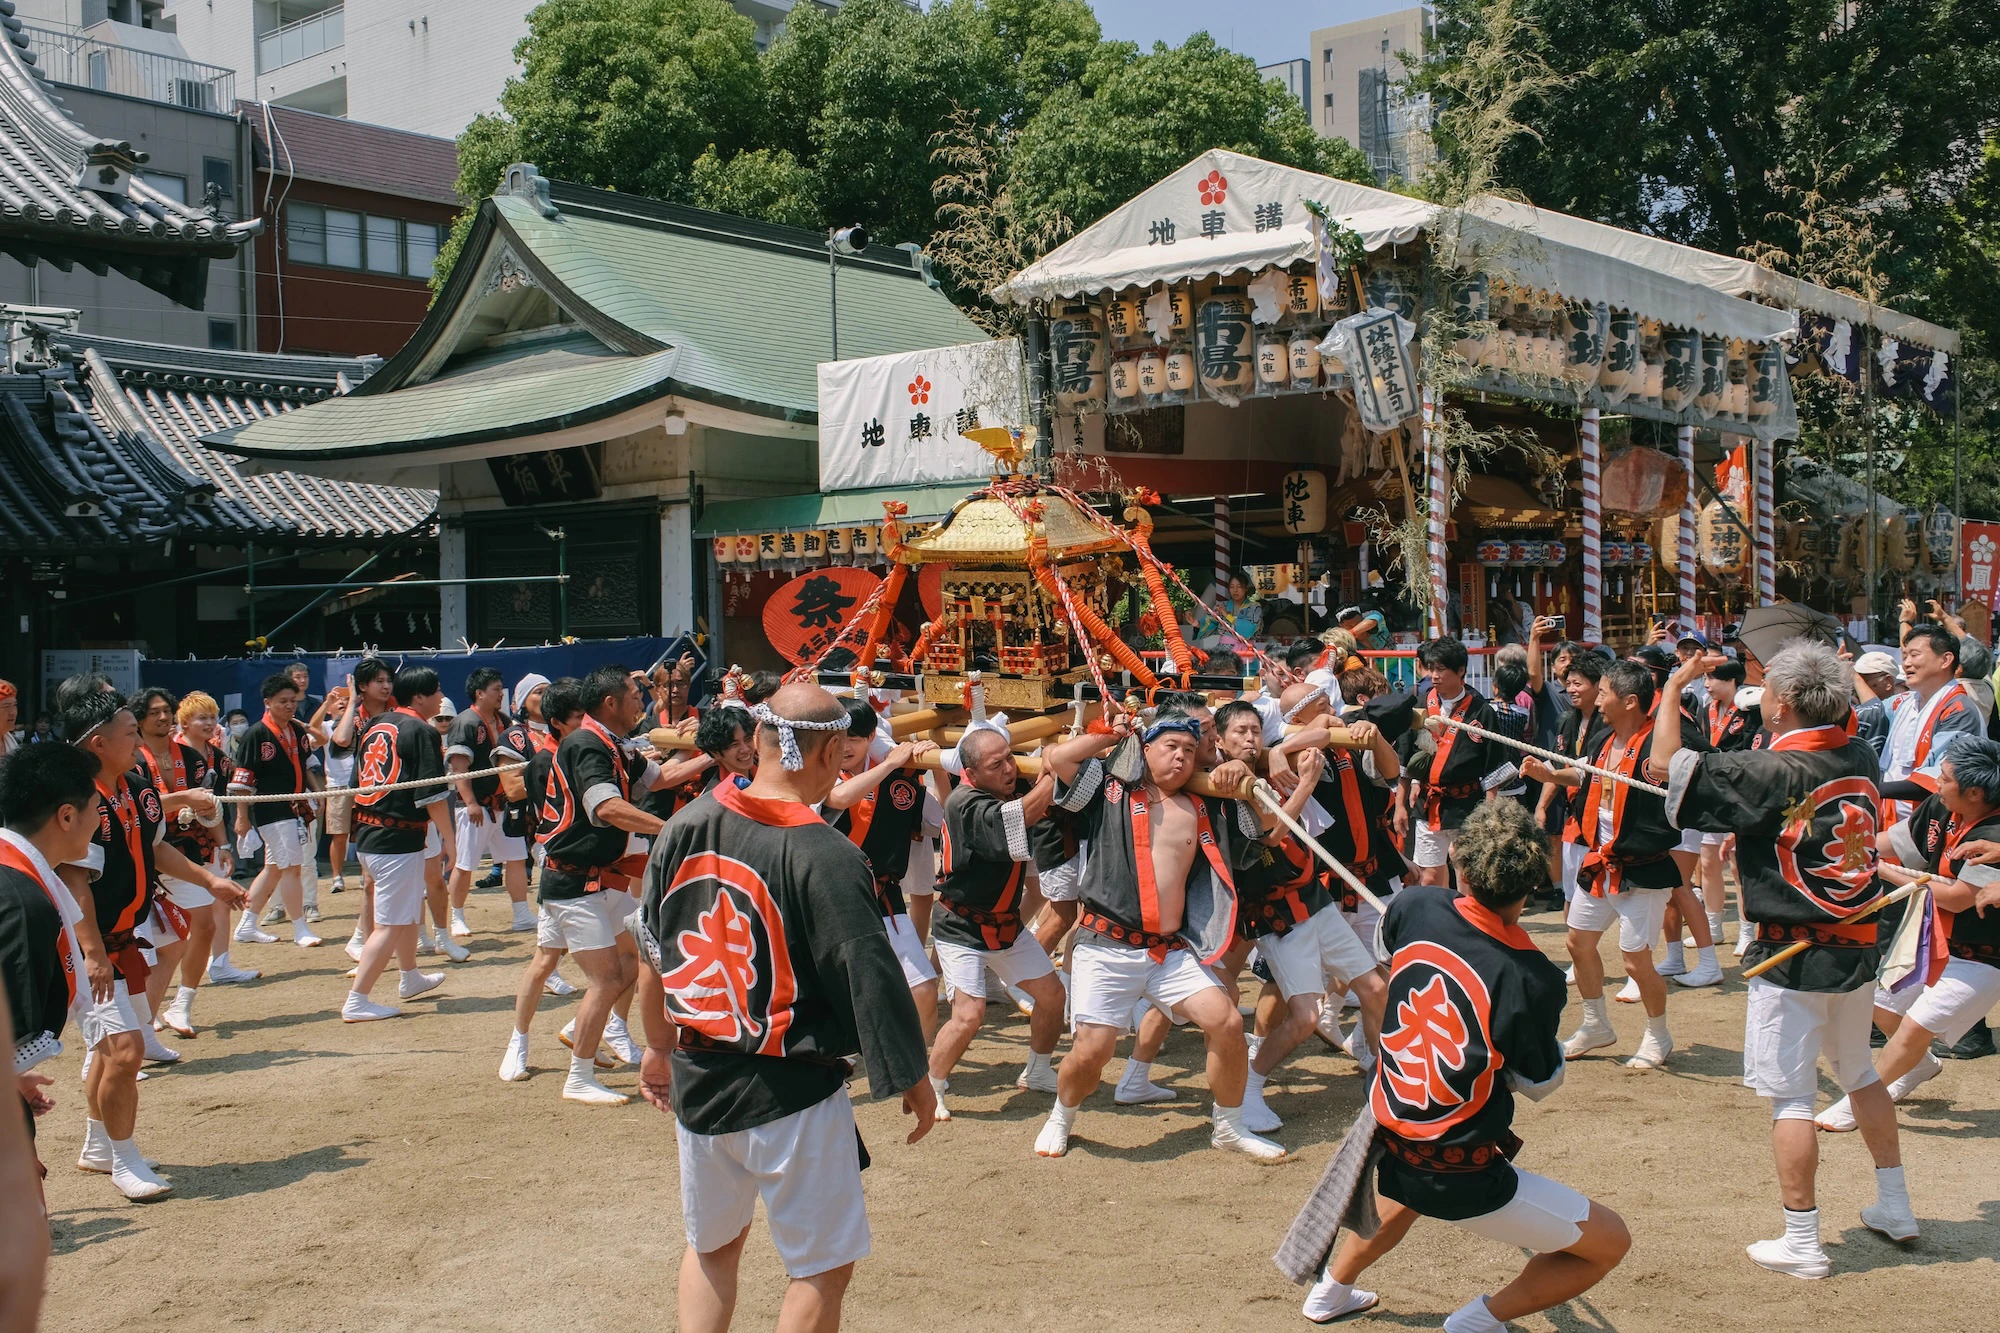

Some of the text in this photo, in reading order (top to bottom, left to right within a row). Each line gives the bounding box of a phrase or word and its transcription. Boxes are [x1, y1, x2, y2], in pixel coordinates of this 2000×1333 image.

[1148, 202, 1284, 246] 地車講
[1261, 351, 1276, 375] 地車
[1293, 346, 1308, 370] 地車
[1113, 366, 1127, 390] 地車
[1141, 365, 1155, 387] 地車
[1167, 360, 1181, 383] 地車
[1285, 473, 1311, 533] 地車
[790, 575, 857, 628] 祭
